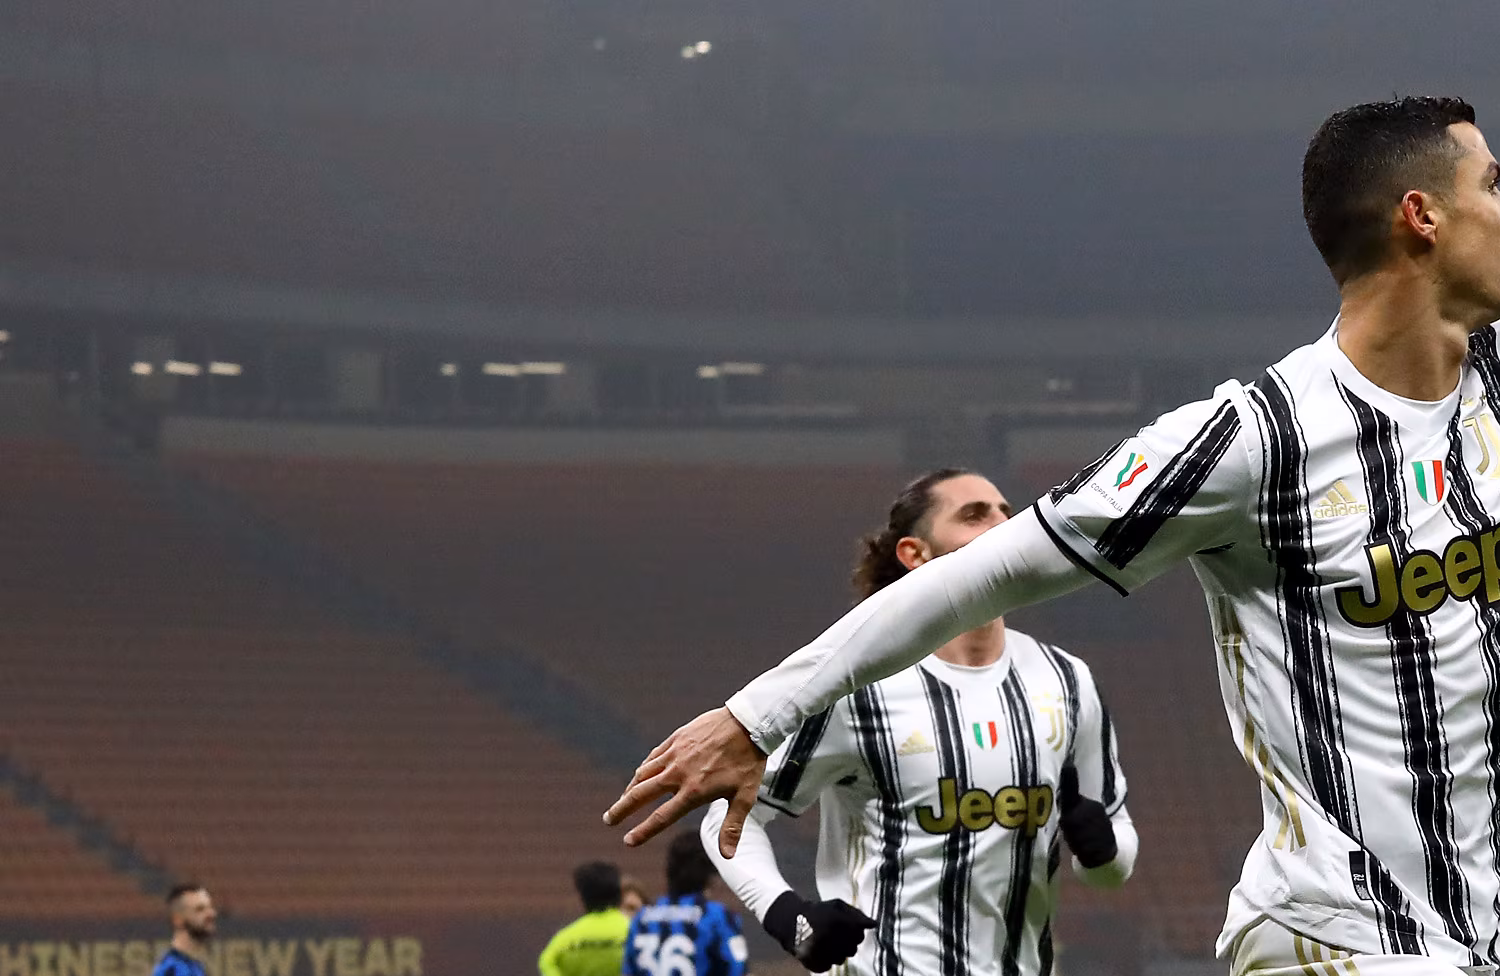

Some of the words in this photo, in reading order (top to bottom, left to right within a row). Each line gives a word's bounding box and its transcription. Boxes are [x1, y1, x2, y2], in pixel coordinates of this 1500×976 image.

[1090, 482, 1108, 499] COPPA
[1107, 496, 1123, 513] ITALIA
[1314, 503, 1367, 519] adidas
[915, 777, 1053, 838] Jeep
